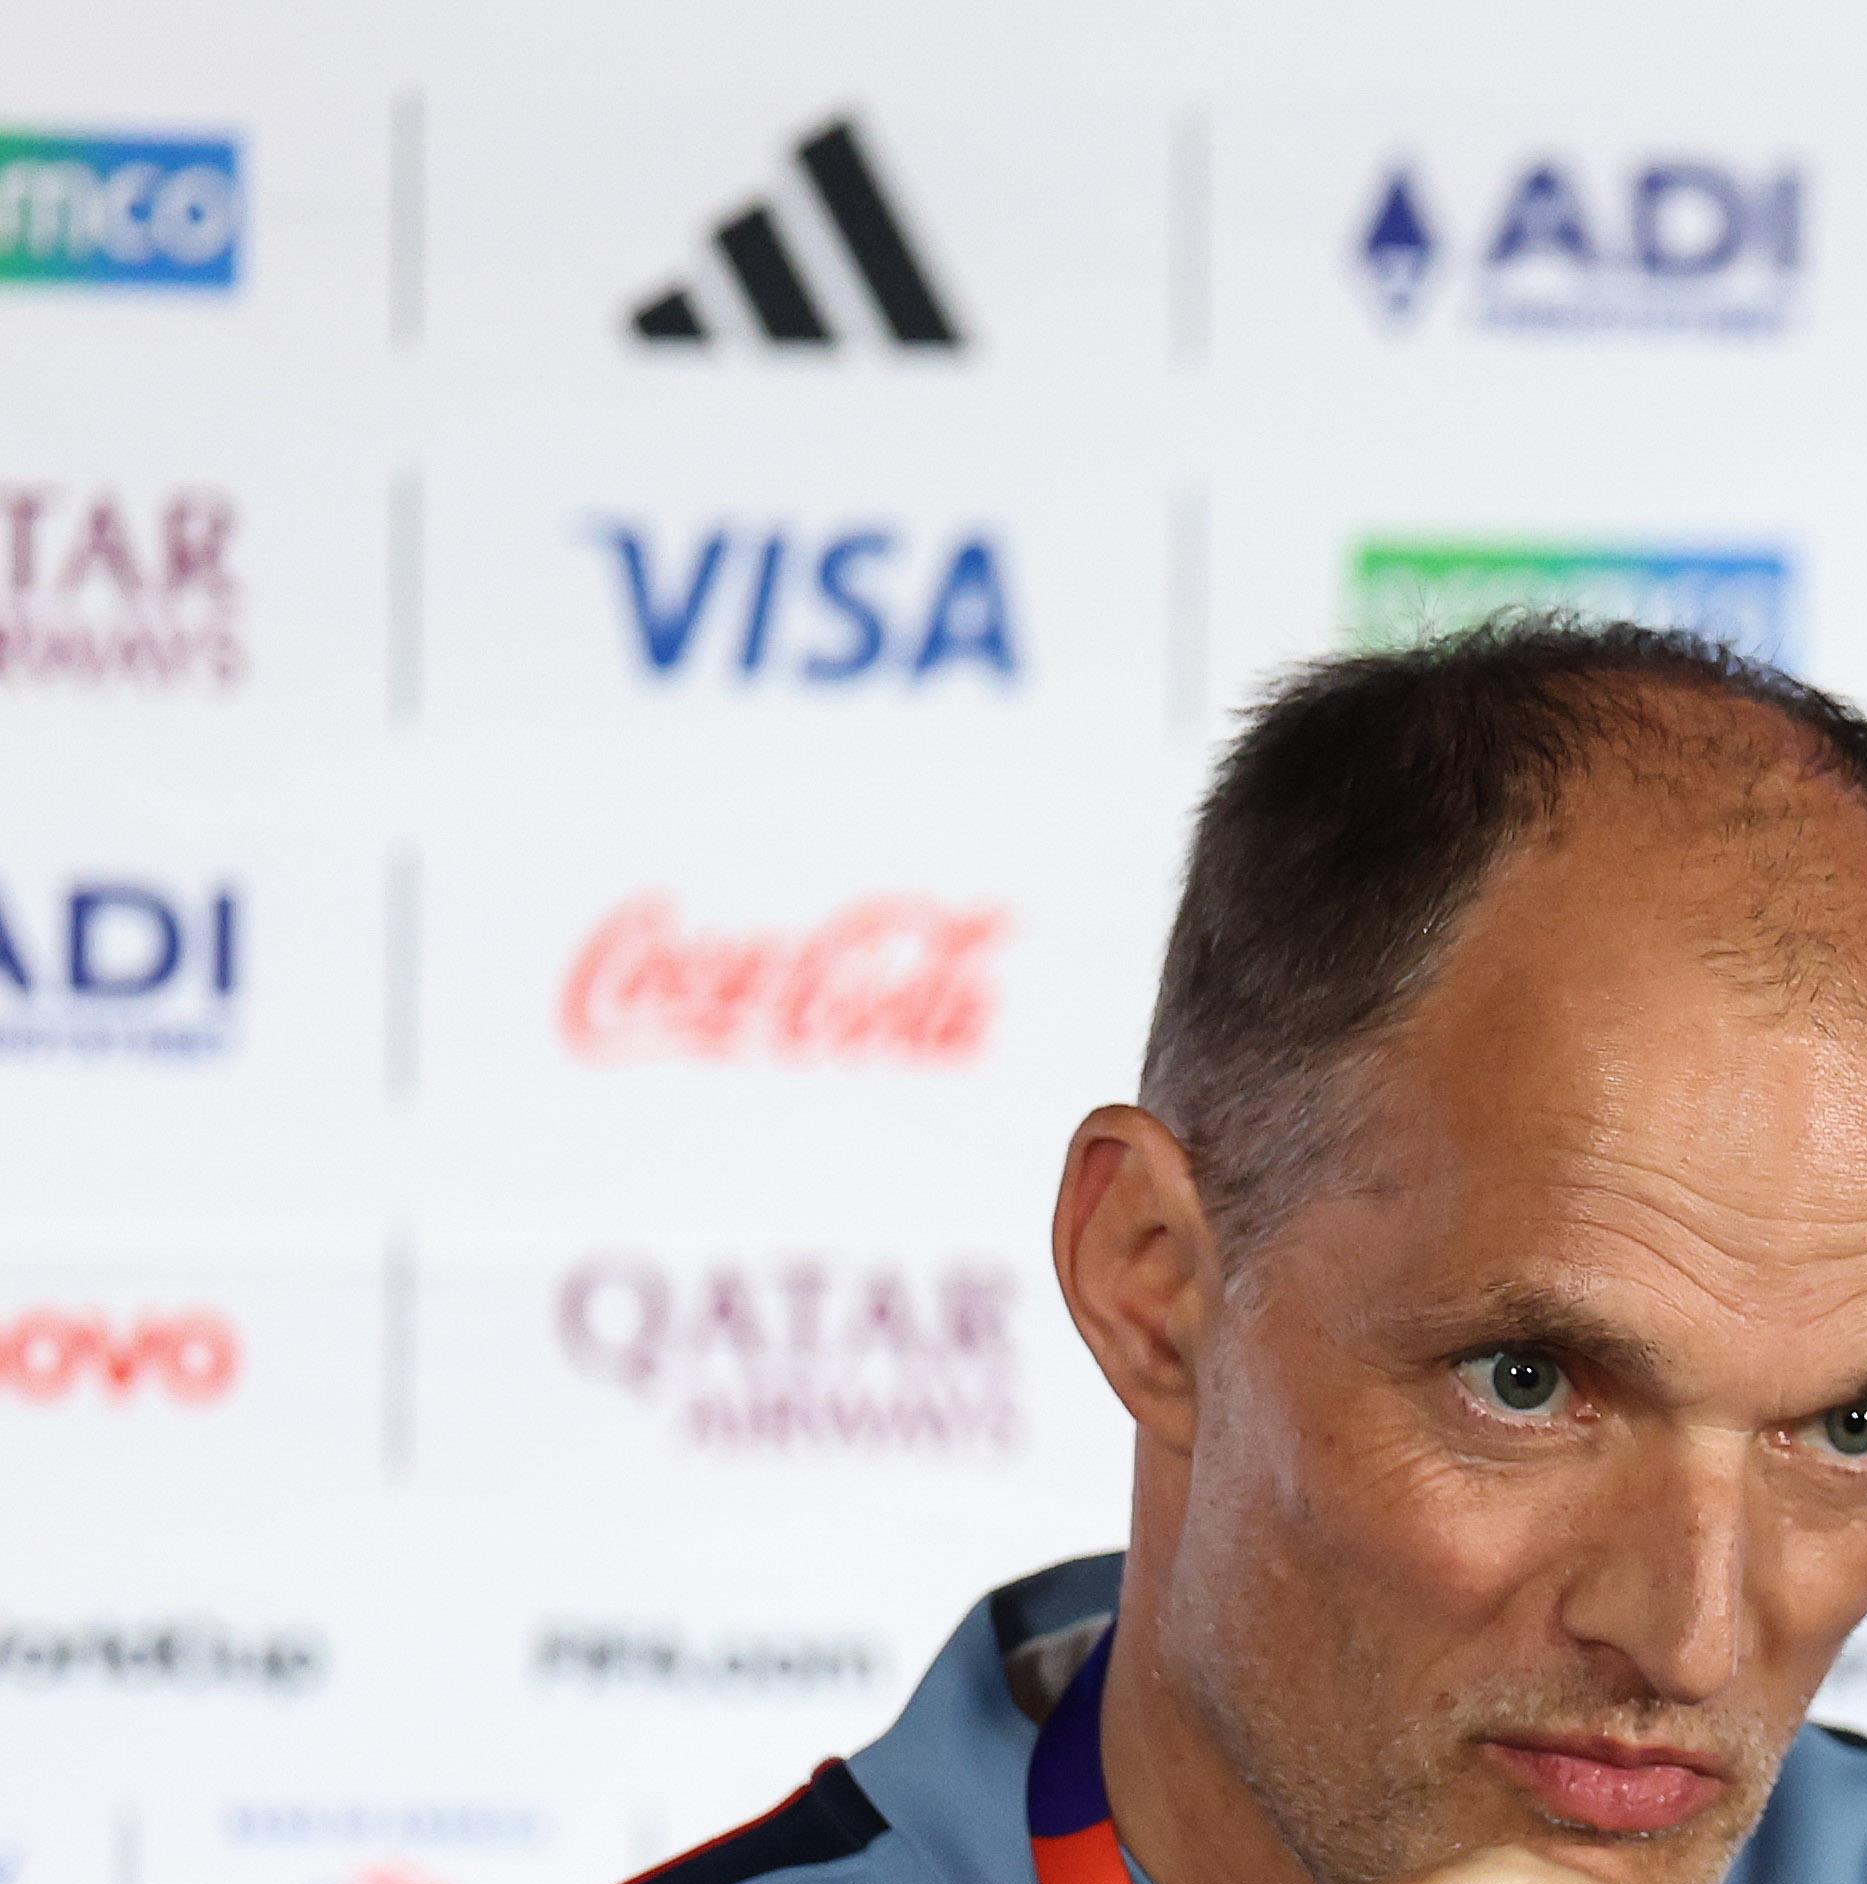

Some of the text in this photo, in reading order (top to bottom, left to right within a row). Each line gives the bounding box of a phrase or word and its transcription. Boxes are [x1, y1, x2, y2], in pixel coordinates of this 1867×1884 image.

[0, 160, 240, 265] mco
[1481, 155, 1803, 276] ADI
[0, 490, 236, 598] TAR
[598, 522, 1022, 685] VISA
[0, 1308, 240, 1404] ovo
